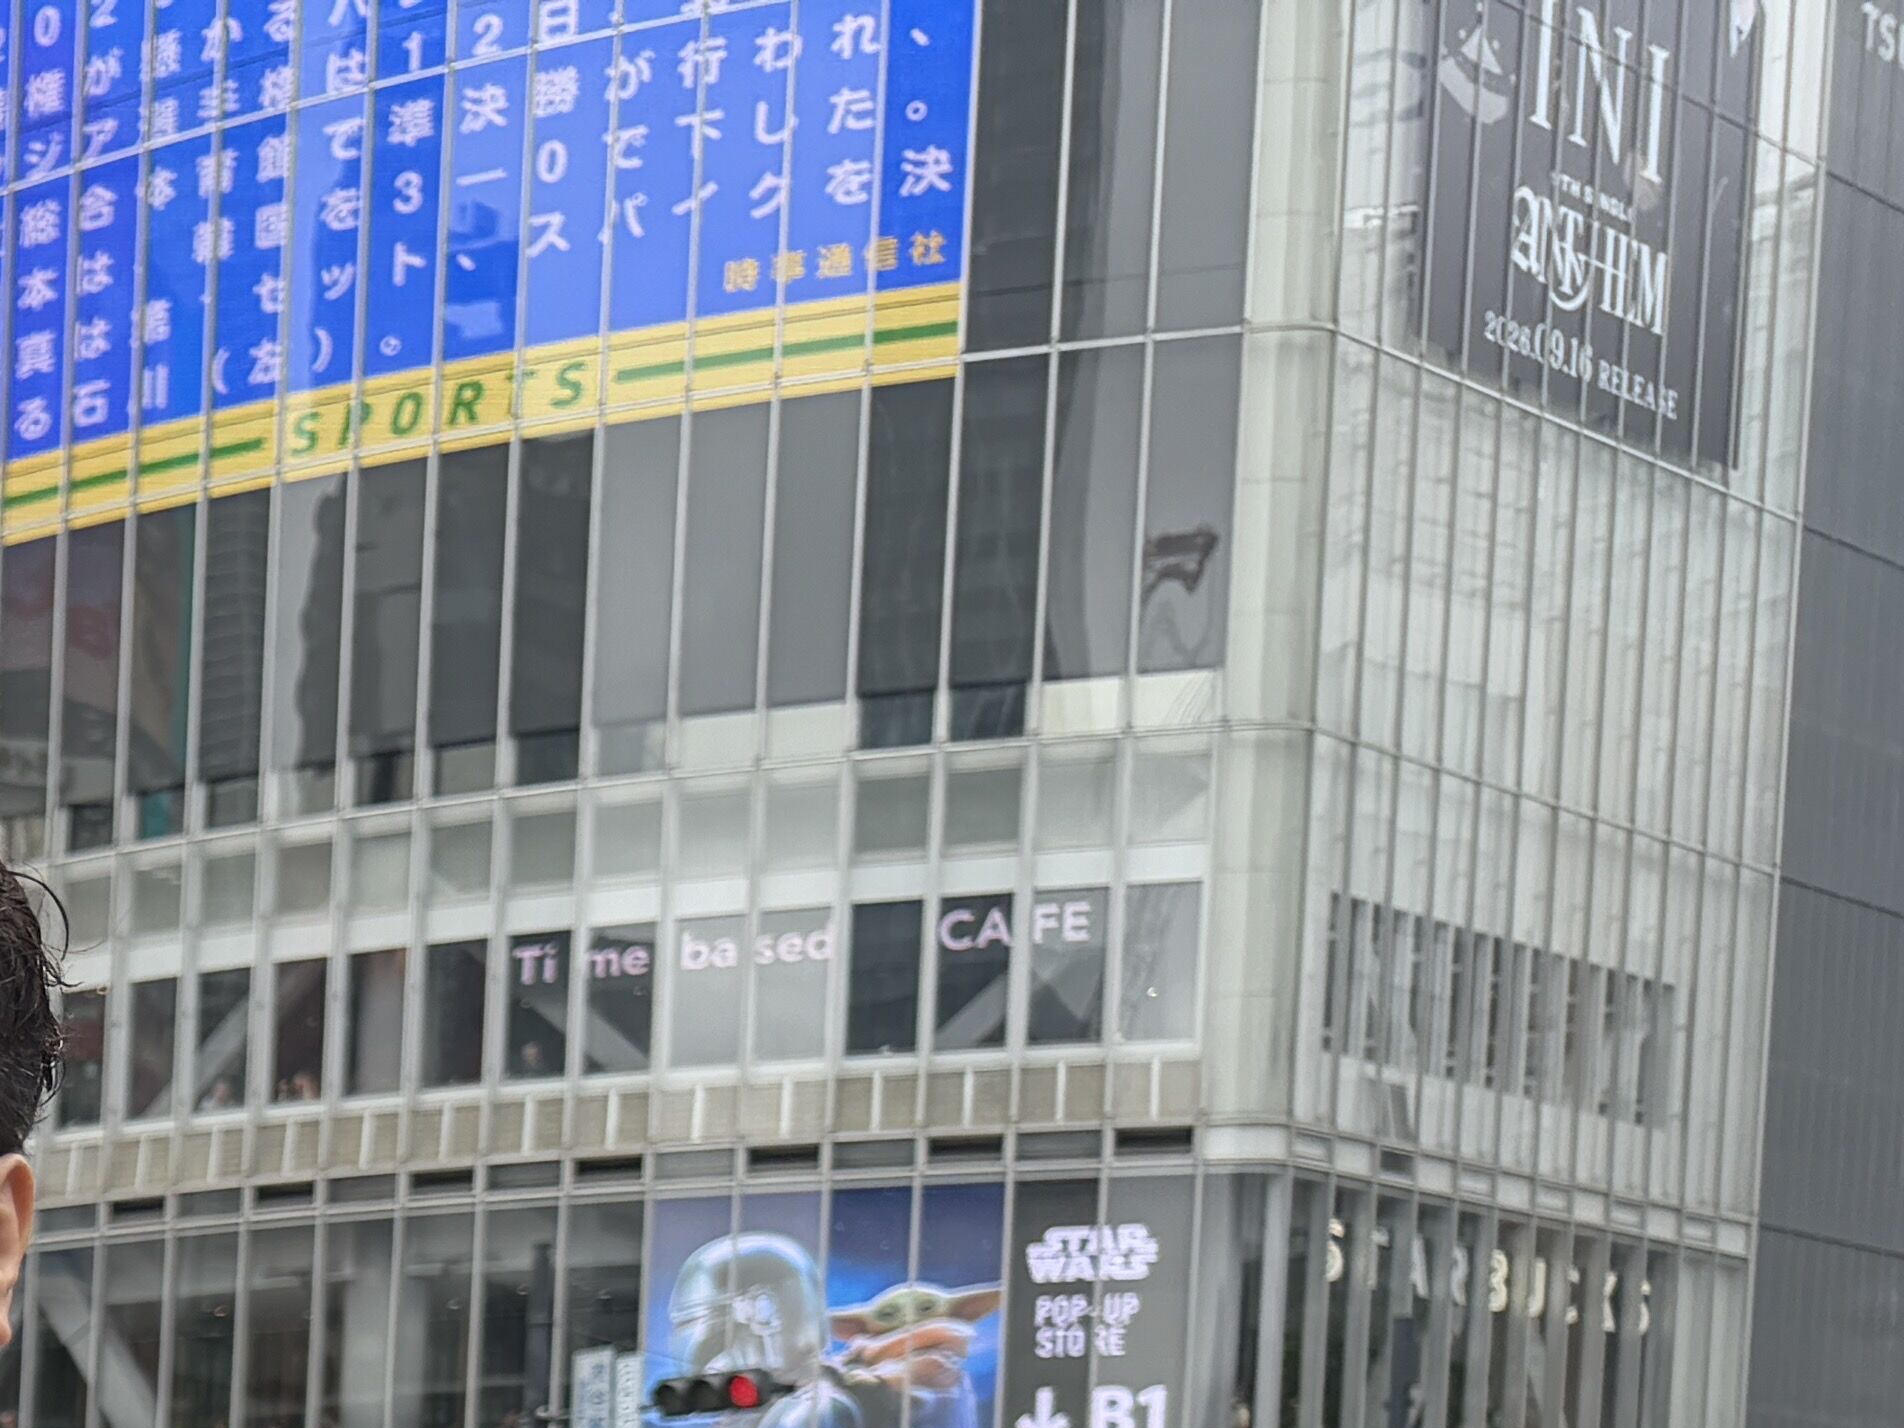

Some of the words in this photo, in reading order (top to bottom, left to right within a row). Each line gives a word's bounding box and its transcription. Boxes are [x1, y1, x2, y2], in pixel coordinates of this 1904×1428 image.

[1530, 0, 1670, 184] INI
[291, 360, 589, 456] SPORTS
[1597, 358, 1680, 421] RELEASE
[939, 901, 1092, 950] CAFE
[1034, 1292, 1141, 1328] POP-UP
[1034, 1325, 1128, 1359] STORE
